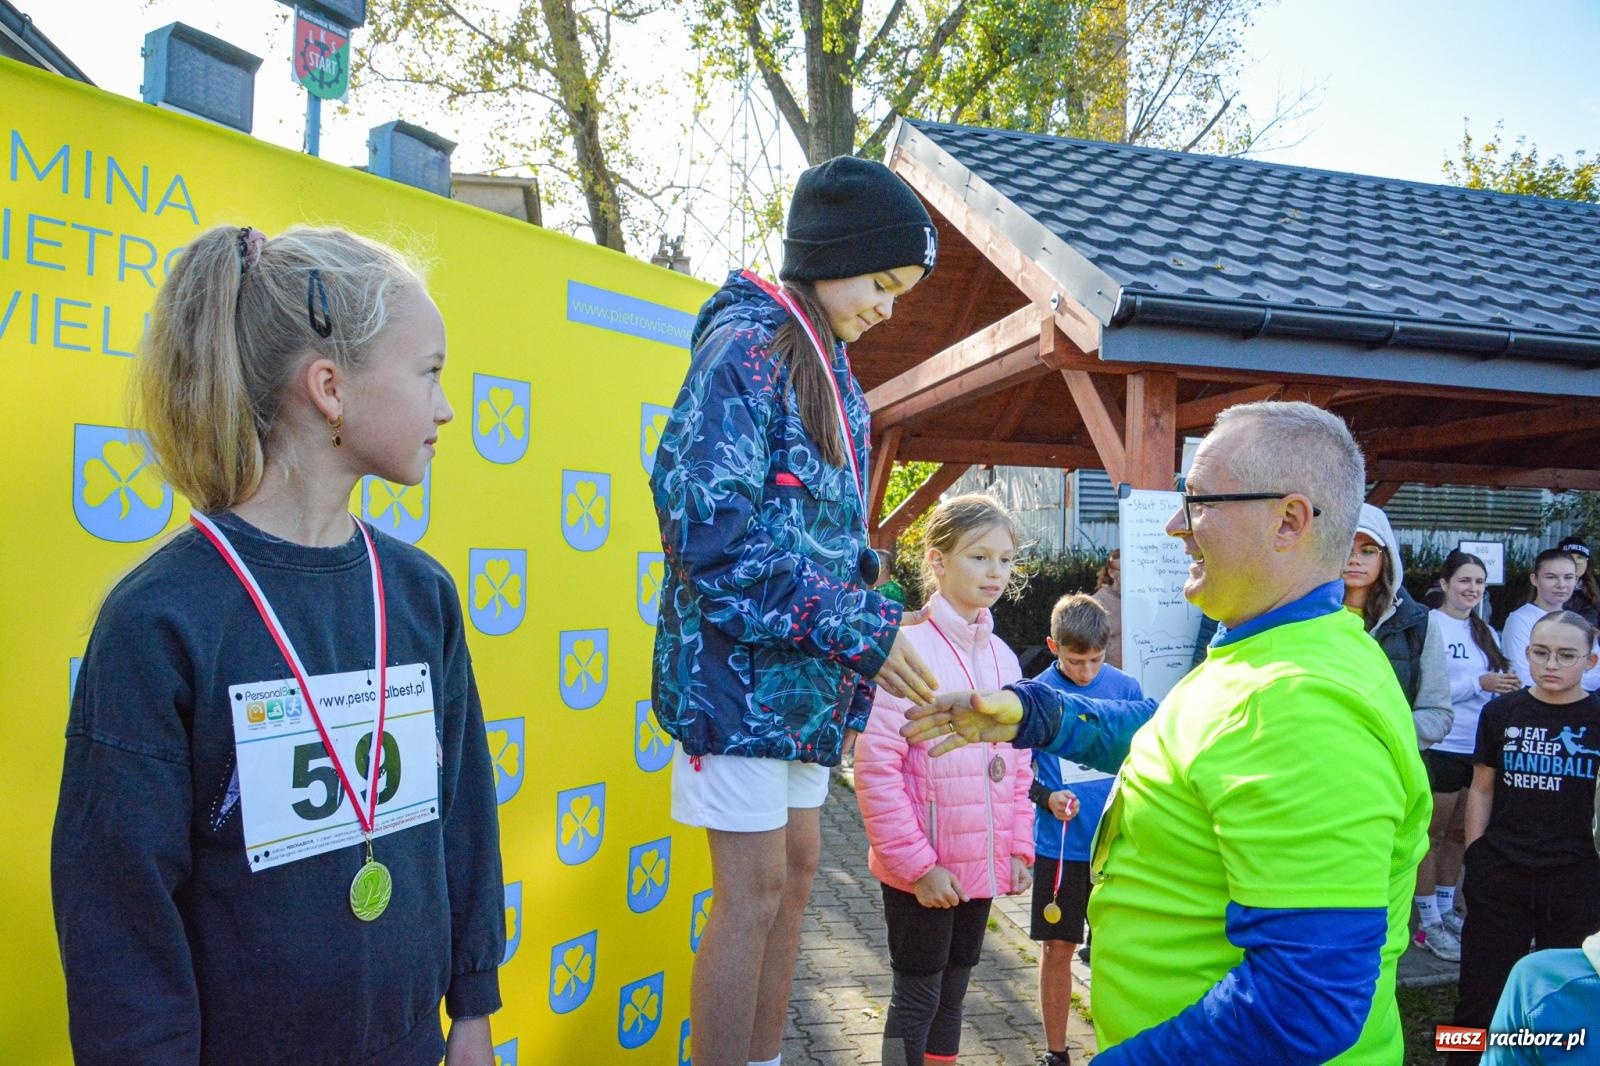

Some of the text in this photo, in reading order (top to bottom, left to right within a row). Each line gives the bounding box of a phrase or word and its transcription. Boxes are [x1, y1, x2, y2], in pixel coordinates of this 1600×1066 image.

[309, 51, 337, 75] START
[1448, 642, 1469, 659] 22
[1524, 727, 1548, 741] EAT
[1521, 740, 1562, 756] SLEEP
[1504, 752, 1595, 779] HANDBALL
[291, 731, 401, 821] 59
[1514, 773, 1562, 791] REPEAT
